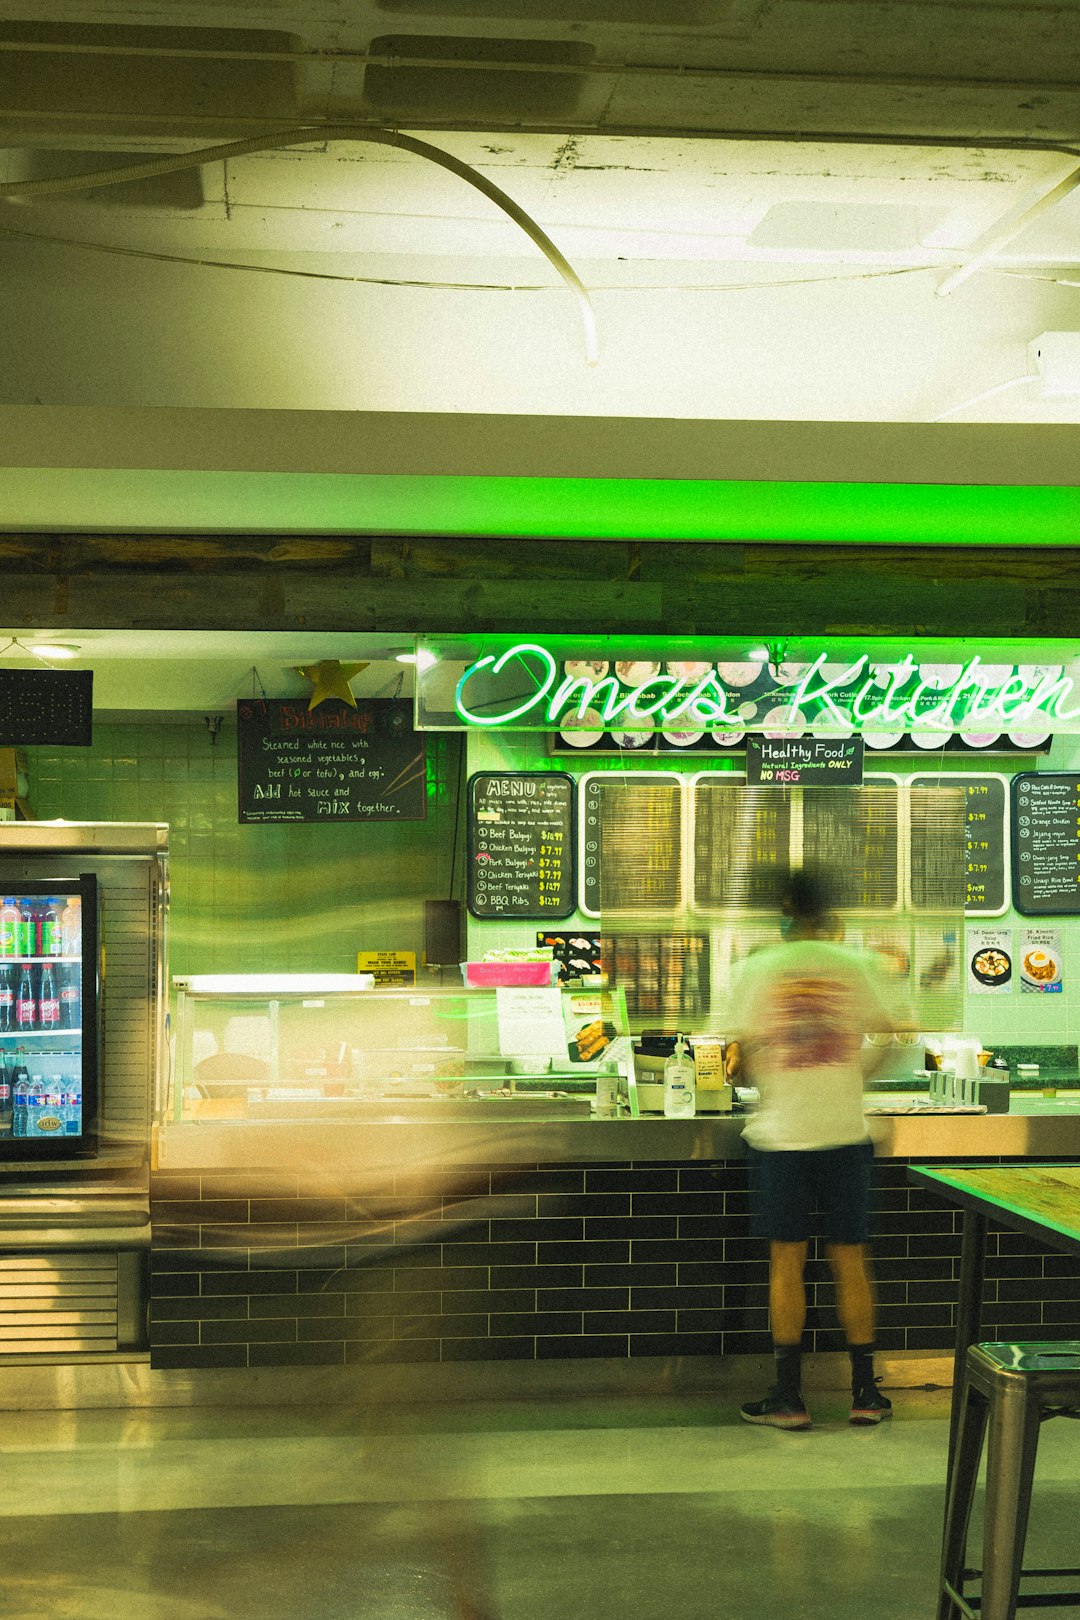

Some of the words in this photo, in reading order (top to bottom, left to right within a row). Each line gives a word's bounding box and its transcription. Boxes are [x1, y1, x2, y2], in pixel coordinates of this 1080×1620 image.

[788, 652, 1080, 731] Kitchen
[262, 737, 299, 751] Steamed
[308, 739, 327, 749] white
[352, 739, 369, 748] with
[277, 753, 312, 764] seasoned
[762, 744, 811, 762] Healthy
[815, 744, 845, 758] Food
[791, 762, 826, 770] Ingredients
[828, 760, 853, 769] ONLY
[268, 768, 285, 778] beef
[349, 767, 365, 778] and
[760, 770, 773, 780] NO
[776, 770, 800, 781] MSG
[254, 784, 281, 799] Add
[289, 785, 302, 798] hot
[308, 789, 330, 798] sauce
[334, 787, 350, 796] and
[486, 780, 536, 798] MENU
[968, 786, 988, 796] $7.99
[357, 801, 400, 816] together.
[968, 813, 986, 821] $7.99
[1032, 819, 1051, 827] Orange
[490, 829, 506, 839] Beef
[509, 829, 532, 842] Bulgogi
[489, 844, 513, 852] Chicken
[514, 843, 536, 855] Bulgogi
[540, 845, 563, 856] $7.99
[967, 841, 989, 850] $7.99
[505, 858, 528, 869] Bulgogi
[539, 858, 561, 868] $7.99
[967, 864, 988, 873] $7.99
[487, 871, 513, 879] Chicken
[515, 871, 538, 880] Teriyaki
[539, 870, 561, 880] $7.99
[490, 896, 509, 906] BBQ
[512, 896, 529, 906] Ribs
[539, 895, 560, 906] $12.99
